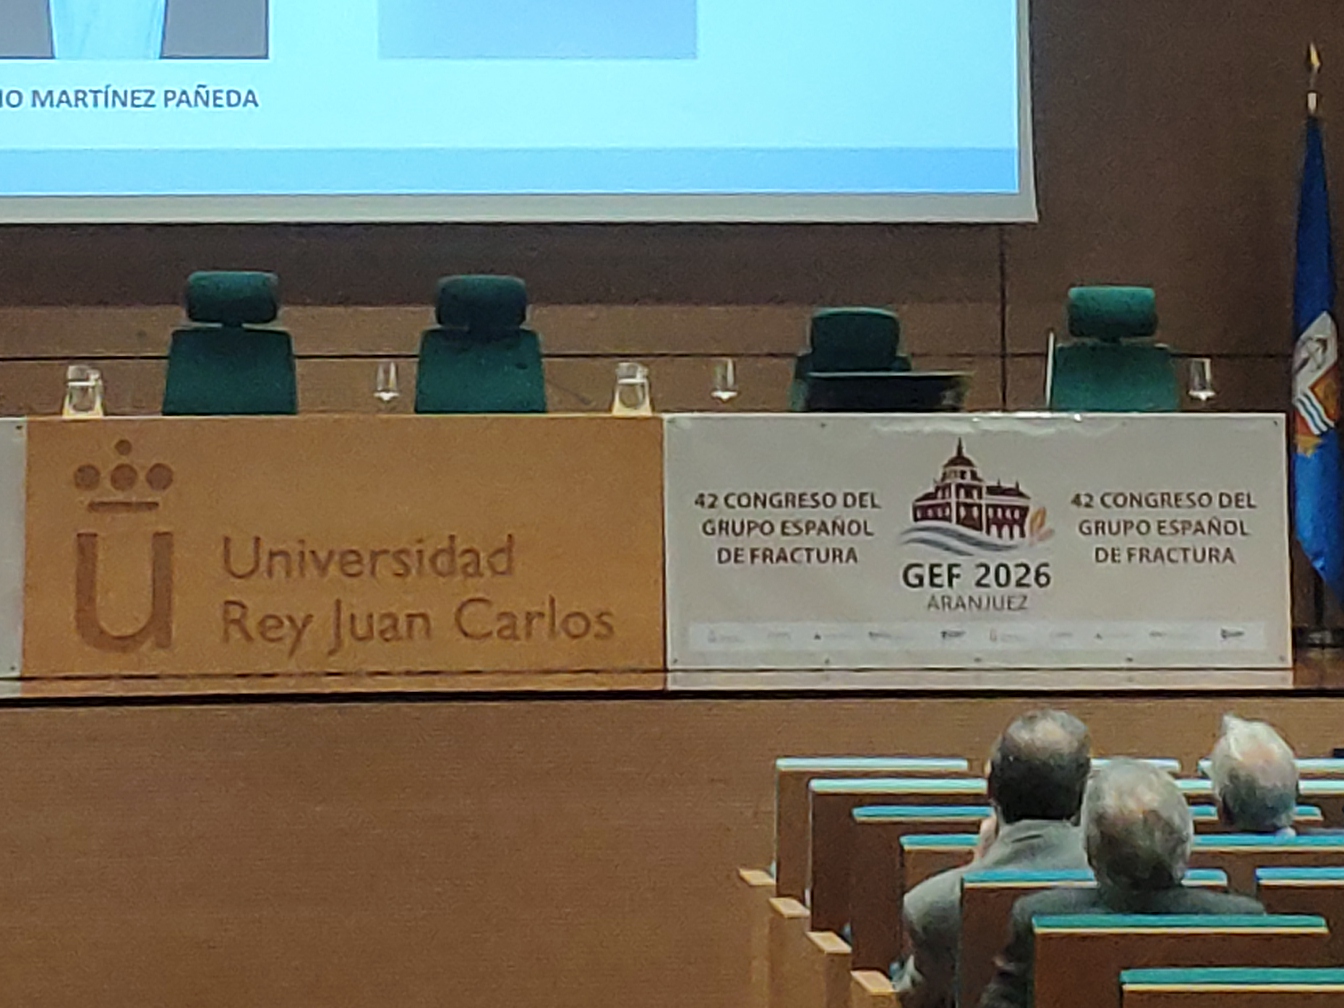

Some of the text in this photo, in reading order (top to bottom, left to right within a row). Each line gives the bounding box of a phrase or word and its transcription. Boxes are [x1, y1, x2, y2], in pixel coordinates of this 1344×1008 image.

[32, 84, 157, 108] MARTÍNEZ
[164, 84, 260, 108] PAÑEDA
[694, 492, 881, 511] 42 CONGRESO DEL
[1071, 491, 1257, 511] 42 CONGRESO DEL
[702, 514, 875, 538] GRUPO ESPAÑOL
[1079, 516, 1250, 536] GRUPO ESPAÑOL
[222, 534, 515, 580] Universidad
[717, 546, 859, 565] DE FRACTURA
[1094, 546, 1236, 564] DE FRACTURA
[902, 561, 1052, 590] GEF 2026
[927, 594, 1029, 612] ARANJUEZ
[221, 595, 616, 660] Rey Juan Carlos
